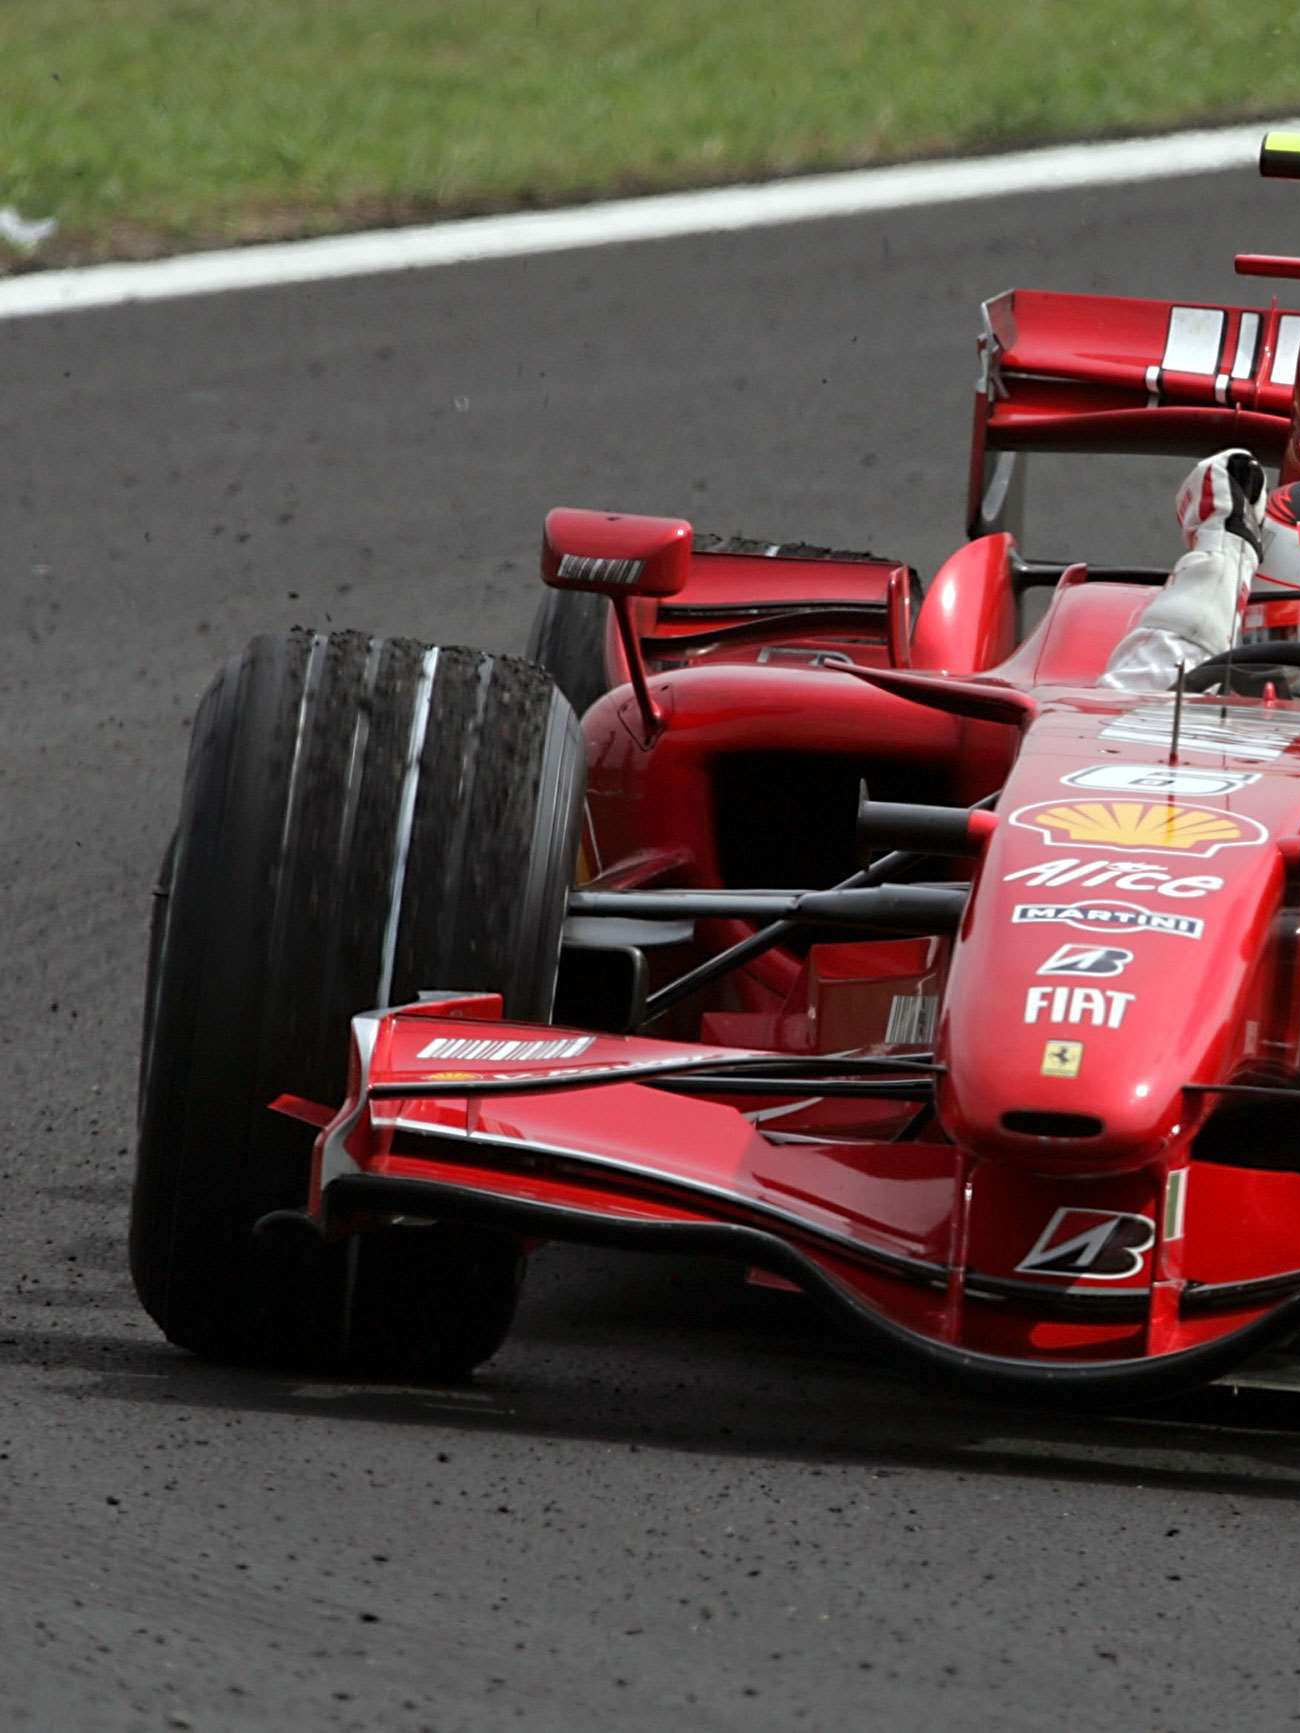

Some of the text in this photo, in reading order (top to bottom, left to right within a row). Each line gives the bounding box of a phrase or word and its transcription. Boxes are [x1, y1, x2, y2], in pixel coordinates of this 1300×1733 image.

[1003, 858, 1224, 898] Alice
[1026, 907, 1190, 932] MARTINI
[1023, 986, 1136, 1029] FIAT
